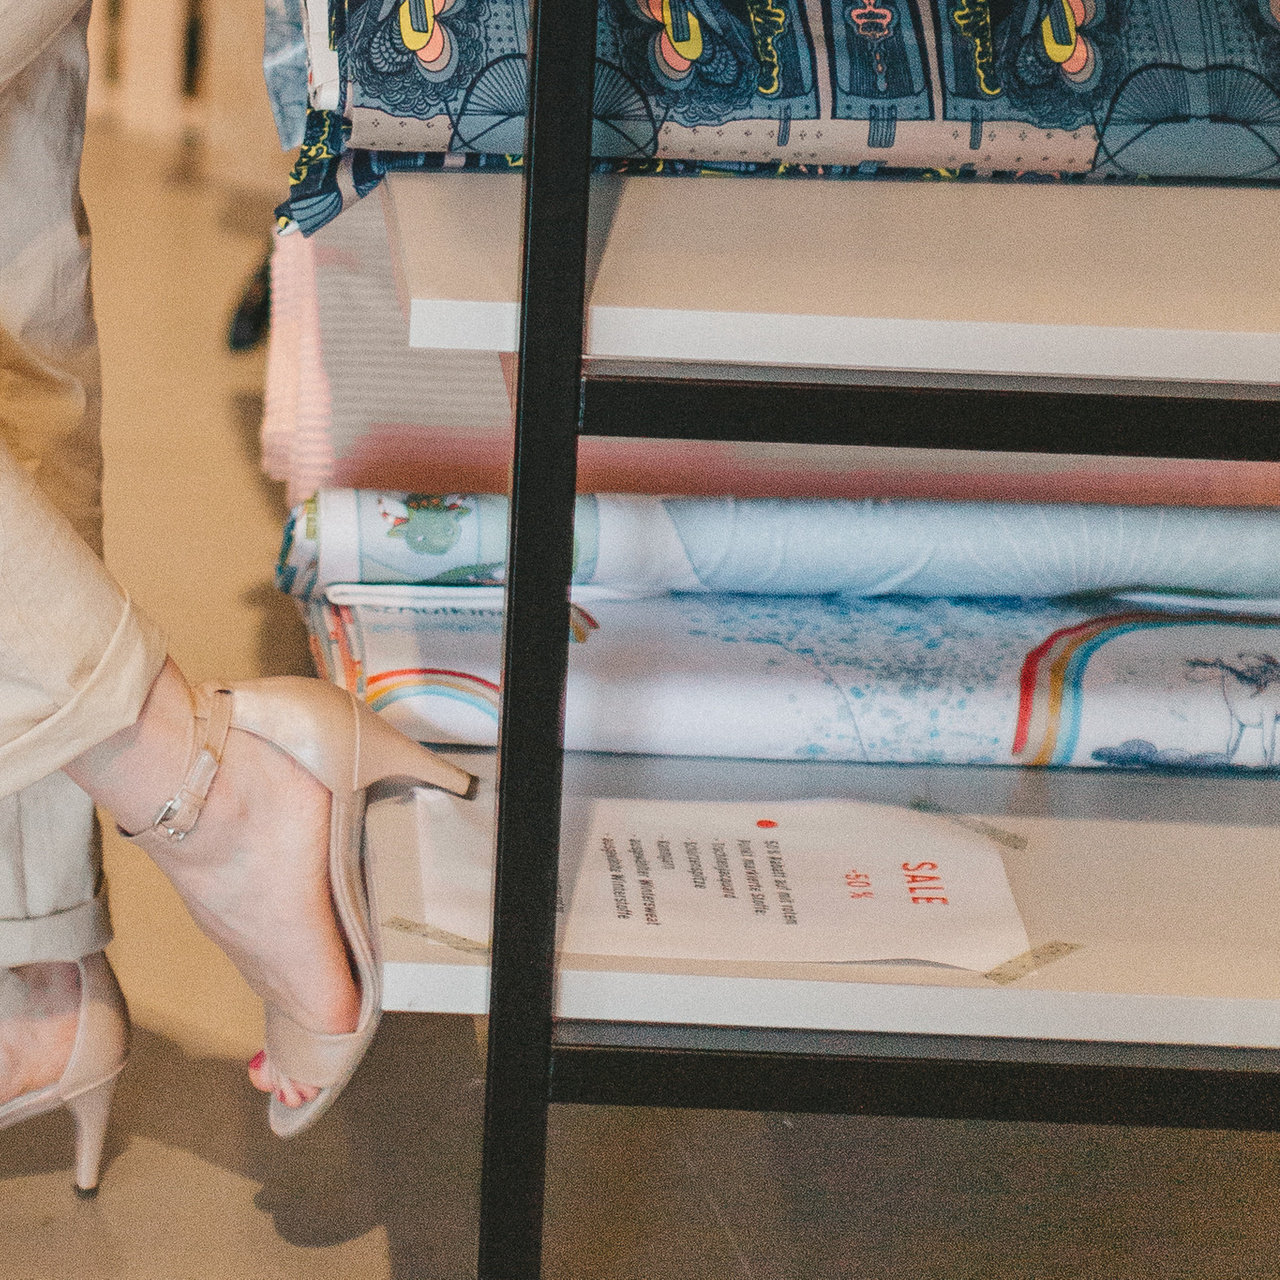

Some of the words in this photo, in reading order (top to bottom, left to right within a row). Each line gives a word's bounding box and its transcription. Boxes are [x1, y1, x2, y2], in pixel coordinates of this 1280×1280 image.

[743, 859, 762, 892] markierte
[767, 856, 788, 878] Rabatt
[611, 874, 633, 919] Winterstoffe
[774, 879, 793, 891] auf
[901, 861, 949, 905] SALE
[638, 879, 662, 926] Wintersweat
[777, 891, 795, 903] mit
[781, 905, 798, 925] rotem
